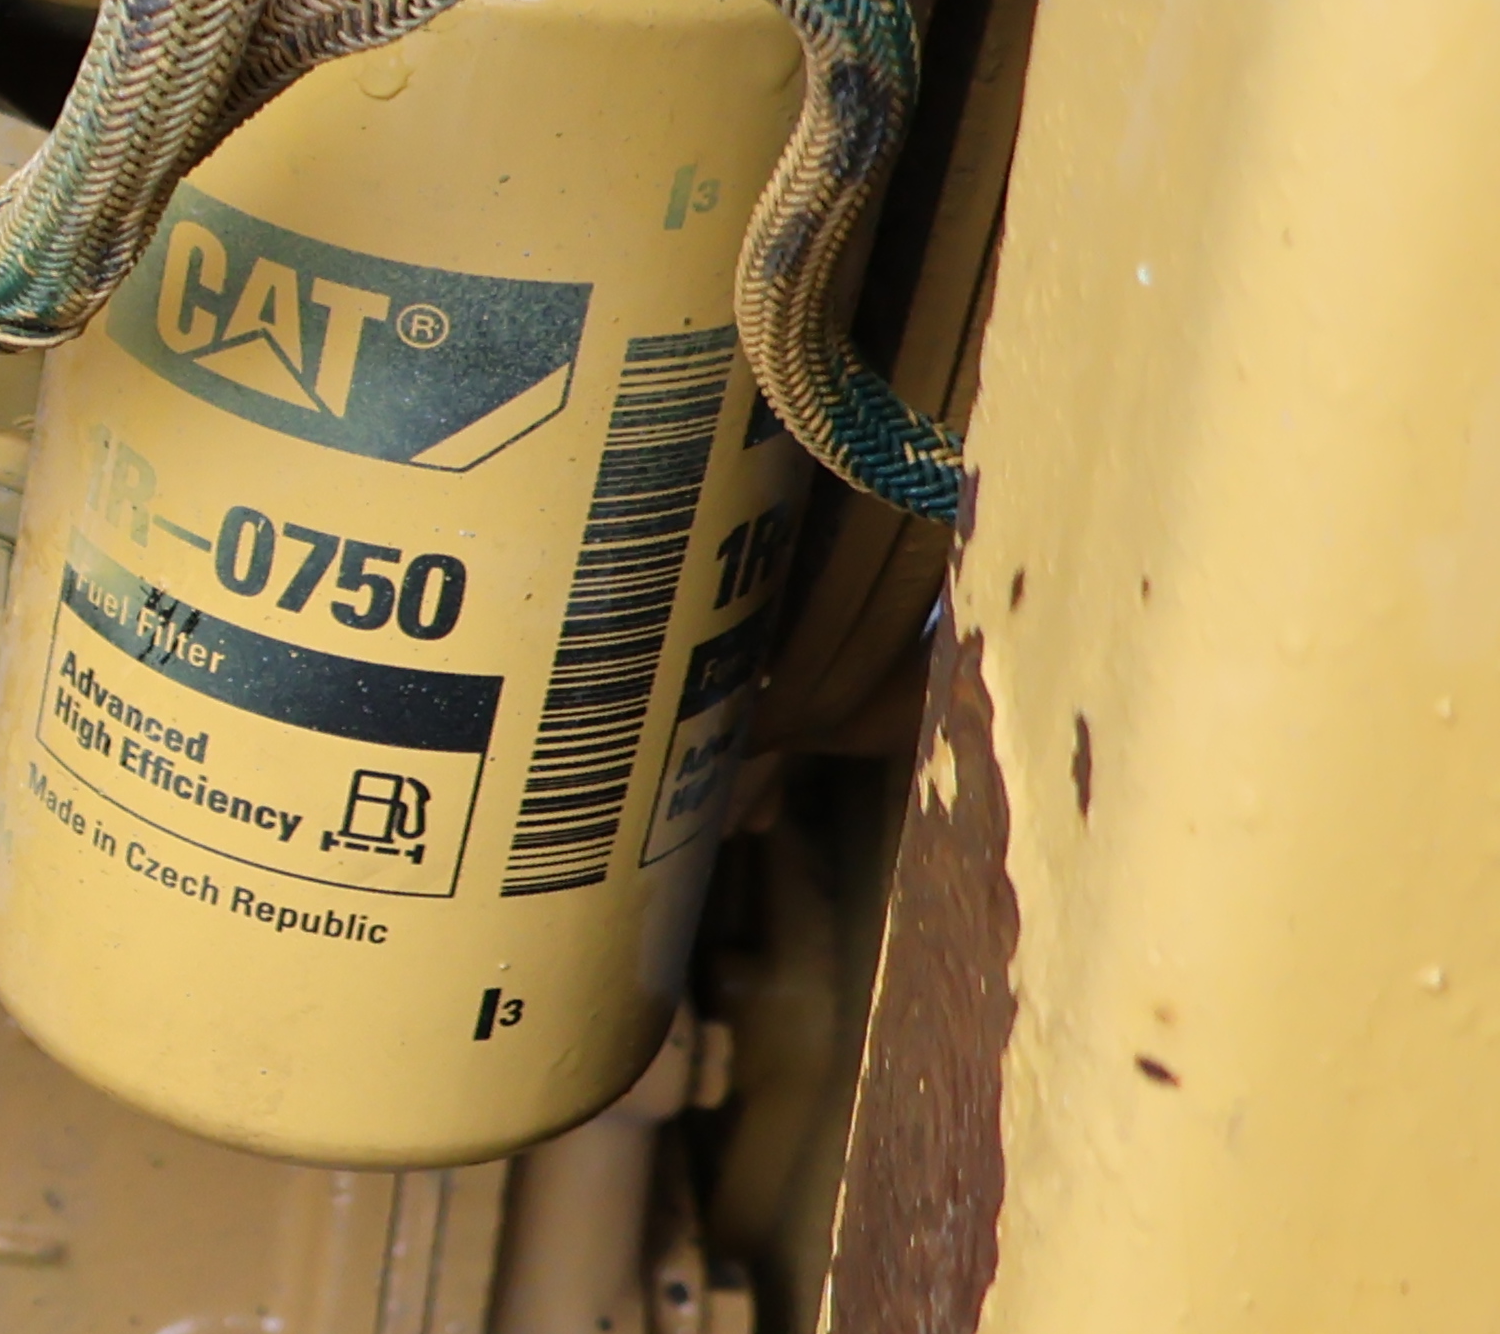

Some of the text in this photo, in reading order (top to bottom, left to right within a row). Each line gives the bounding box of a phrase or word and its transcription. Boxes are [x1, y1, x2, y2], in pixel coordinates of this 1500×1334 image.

[135, 605, 225, 674] Filter
[53, 686, 304, 842] High Efficiency
[58, 651, 209, 764] Advanced
[27, 762, 390, 945] Made in Czech Republic
